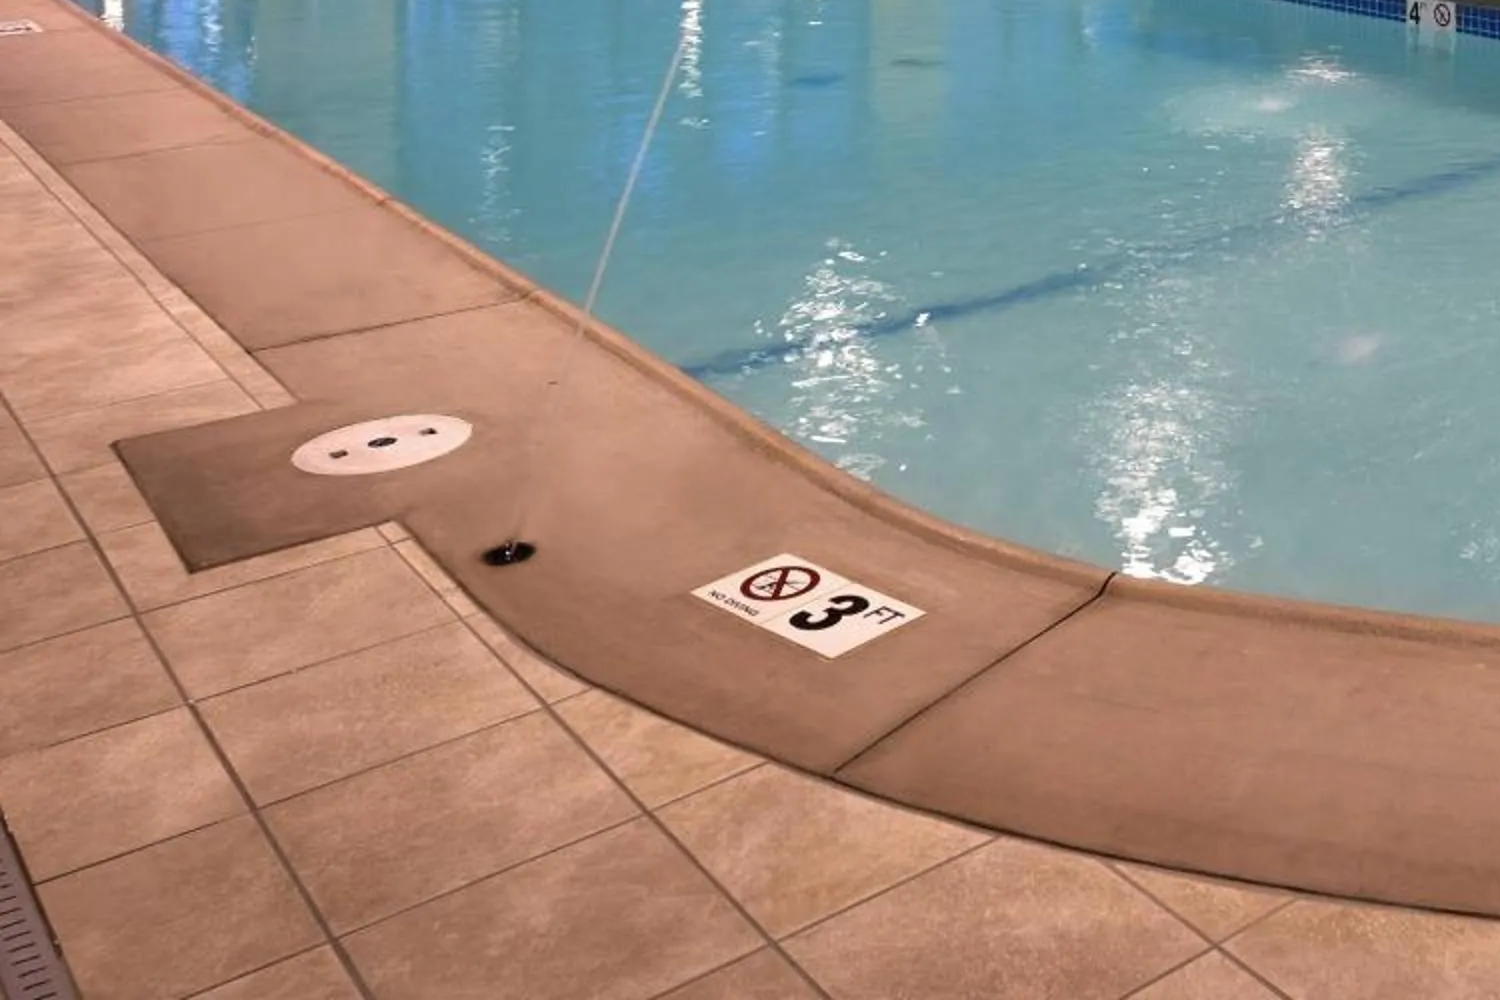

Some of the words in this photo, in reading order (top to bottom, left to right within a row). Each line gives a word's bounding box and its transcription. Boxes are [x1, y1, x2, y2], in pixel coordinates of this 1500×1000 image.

[1410, 1, 1421, 24] 4
[789, 595, 869, 630] 3
[863, 605, 905, 625] FT
